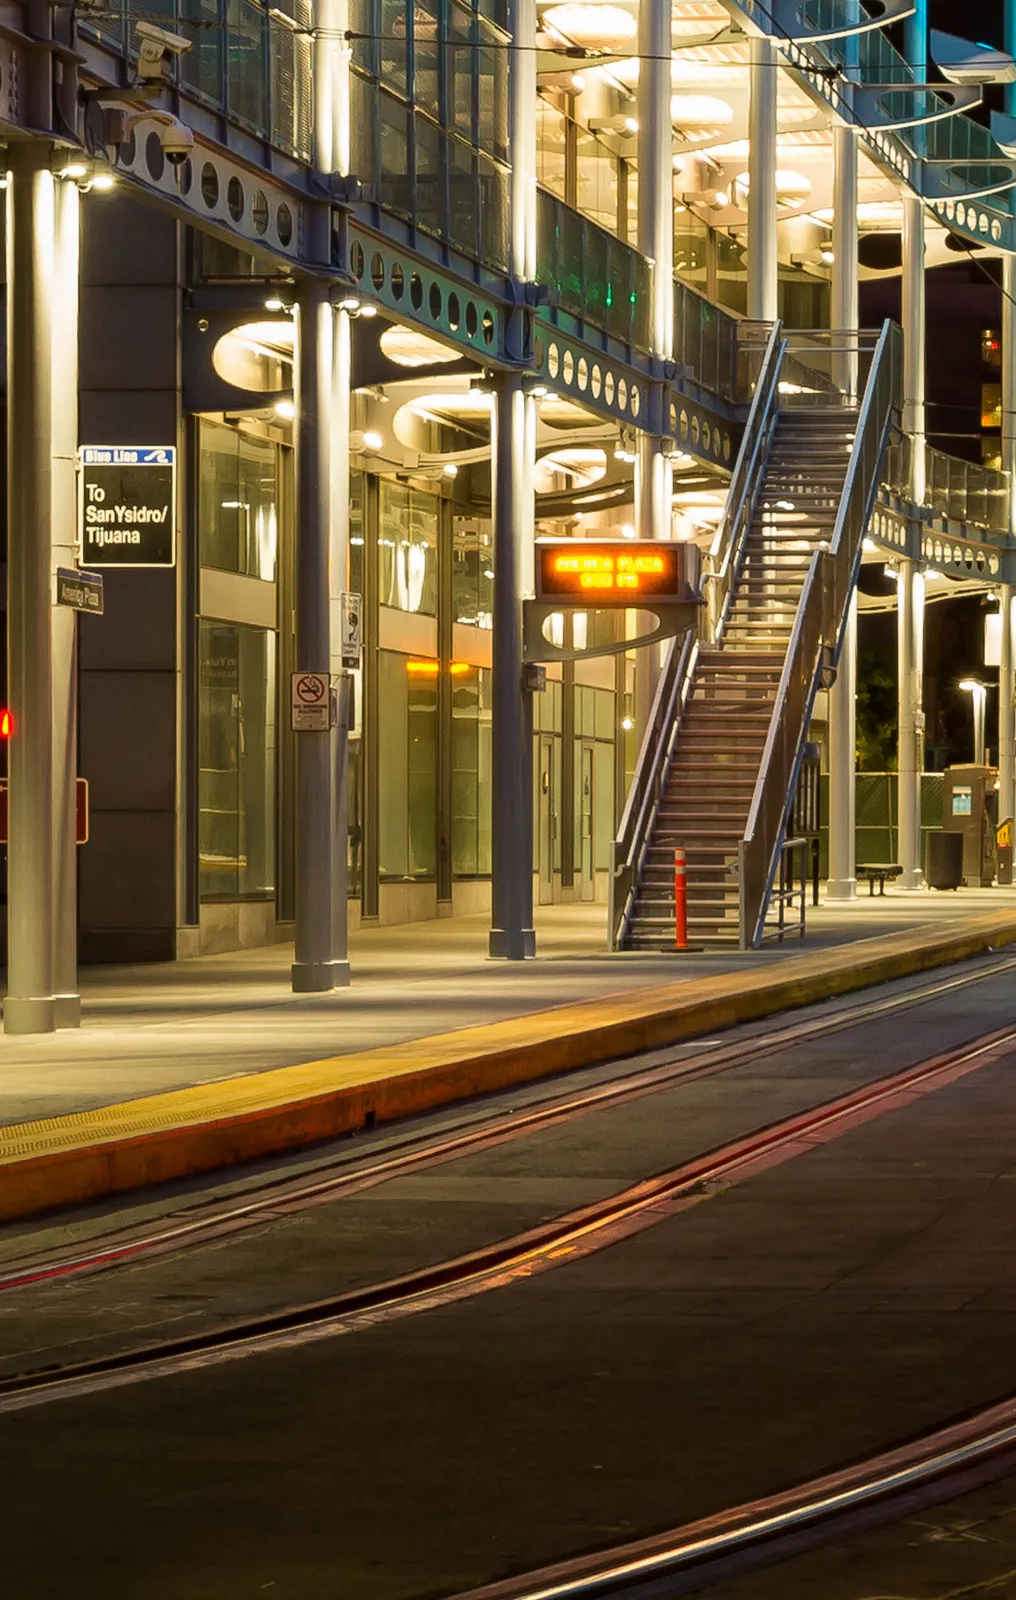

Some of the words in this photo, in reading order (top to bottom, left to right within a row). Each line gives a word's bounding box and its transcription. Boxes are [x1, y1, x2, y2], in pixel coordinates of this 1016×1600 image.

[85, 450, 111, 463] Blue
[113, 450, 138, 463] Line
[86, 484, 105, 502] To
[86, 527, 141, 547] Tijuana
